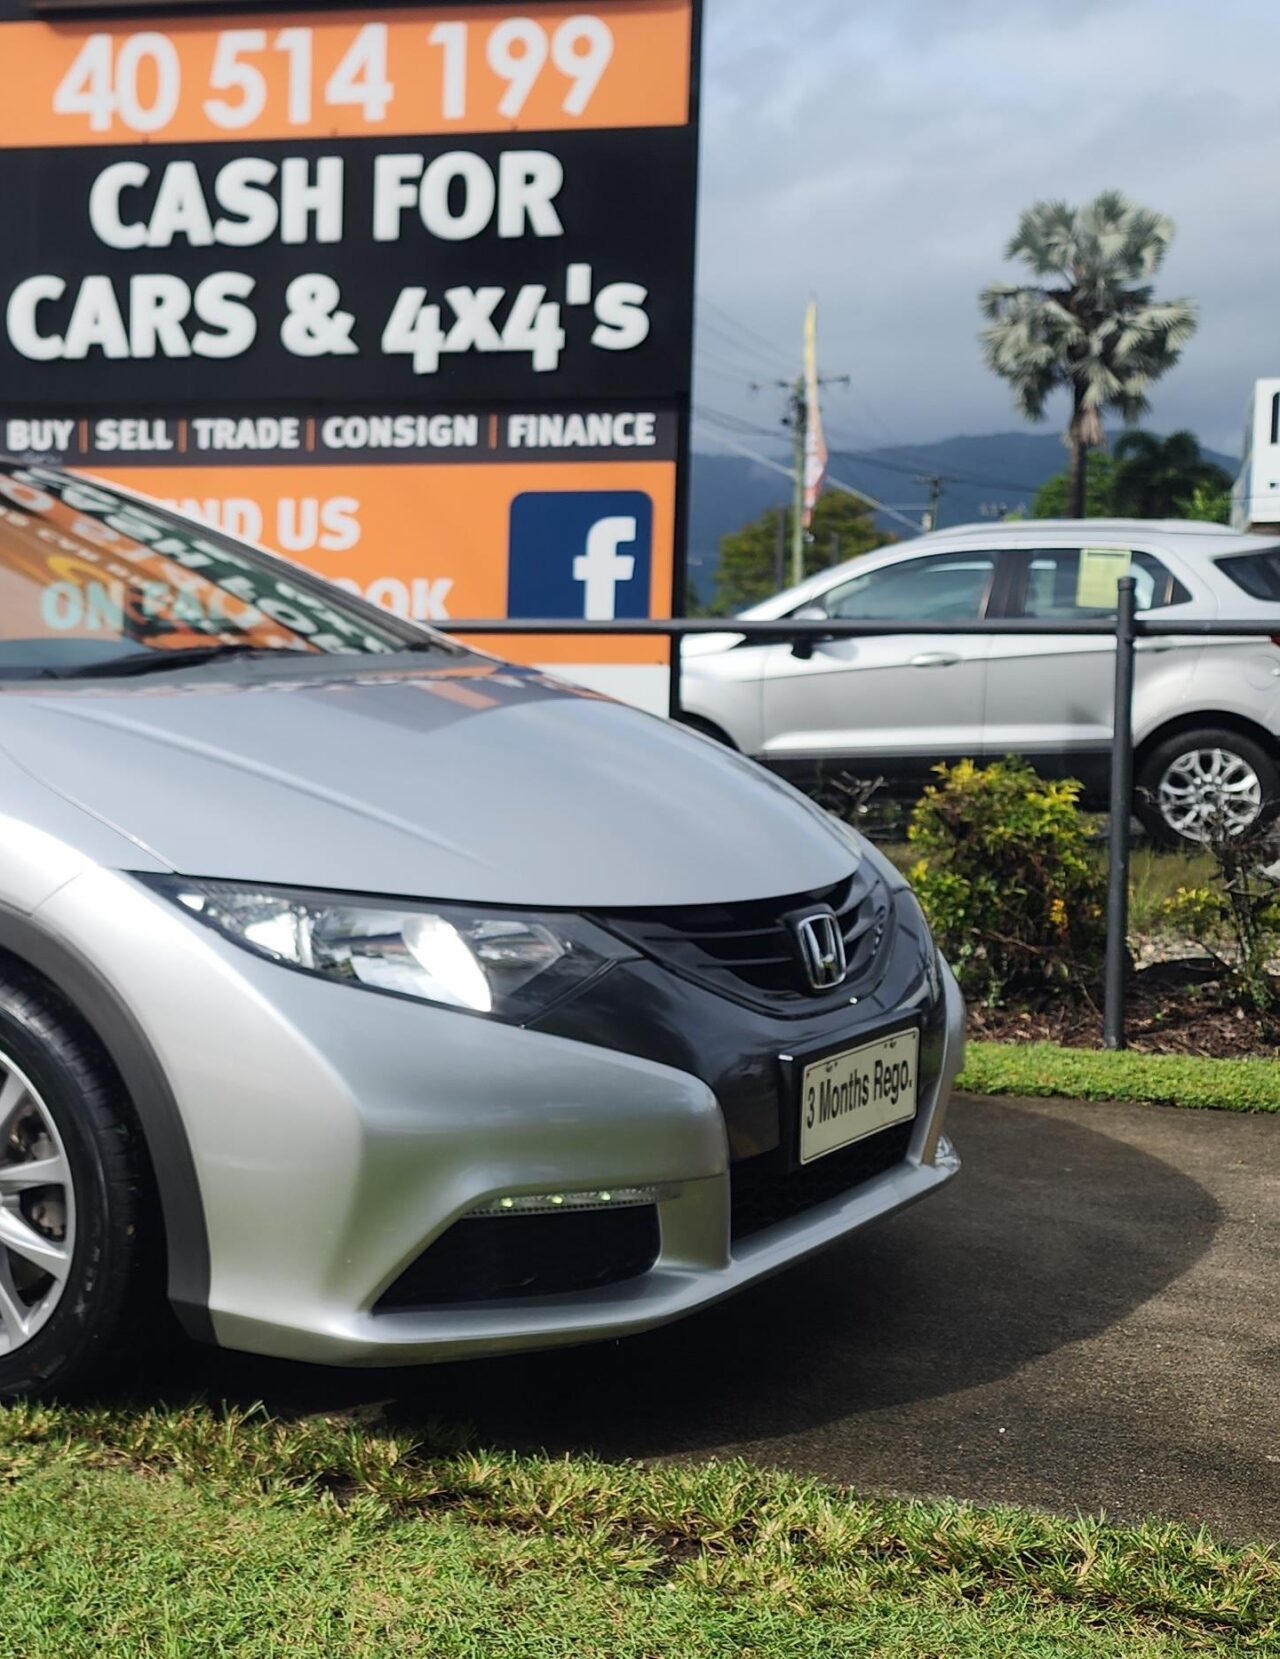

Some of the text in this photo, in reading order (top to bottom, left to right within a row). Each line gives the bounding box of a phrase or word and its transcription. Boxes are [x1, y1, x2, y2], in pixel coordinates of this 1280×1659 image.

[52, 16, 614, 131] 40 514 199
[89, 151, 563, 249] CASH FOR
[6, 272, 257, 360] CARS
[280, 273, 358, 357] &
[7, 412, 656, 450] BUY SELL TRADE CONSIGN FINANCE
[276, 496, 362, 550] US
[41, 580, 124, 631] ON
[807, 1059, 912, 1129] 3 Months Rego.
